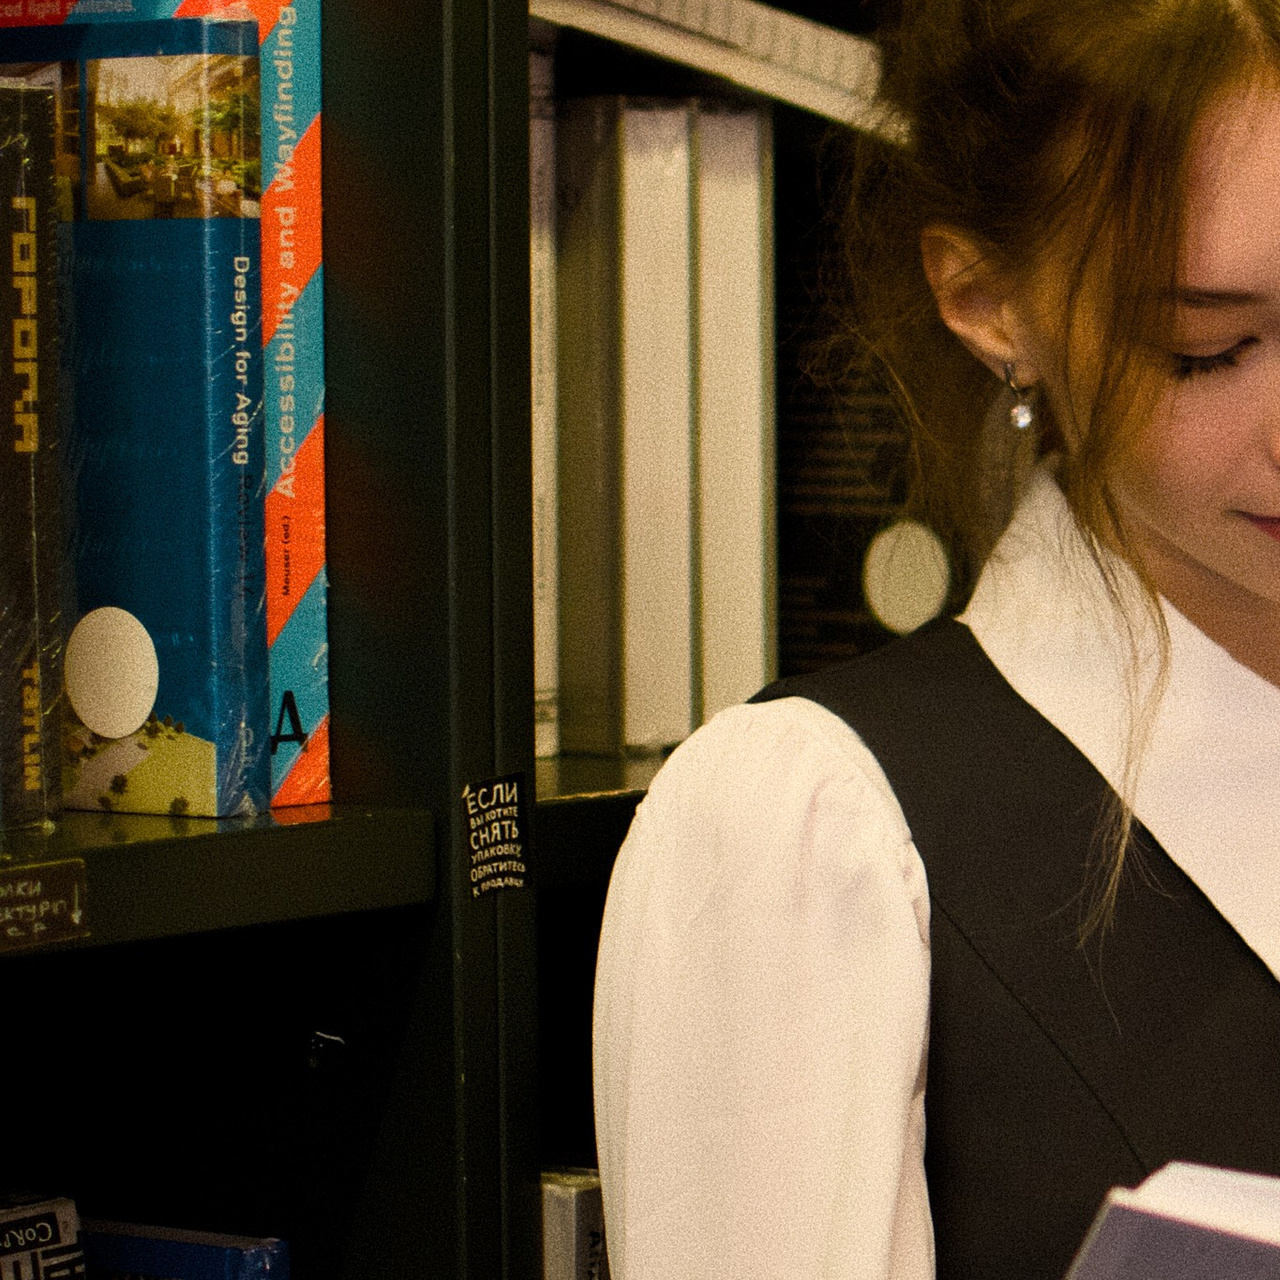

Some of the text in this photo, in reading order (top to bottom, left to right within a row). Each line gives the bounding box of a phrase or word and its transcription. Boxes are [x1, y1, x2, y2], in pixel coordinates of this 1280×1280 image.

[273, 5, 298, 193] Wayfinding
[273, 206, 296, 270] and
[232, 256, 251, 342] Design
[234, 349, 251, 385] for
[273, 281, 299, 499] Accessibility
[232, 394, 251, 466] Aging
[280, 548, 292, 598] Meuser
[466, 781, 519, 815] ЕСЛИ
[469, 819, 520, 850] СНЯТЬ
